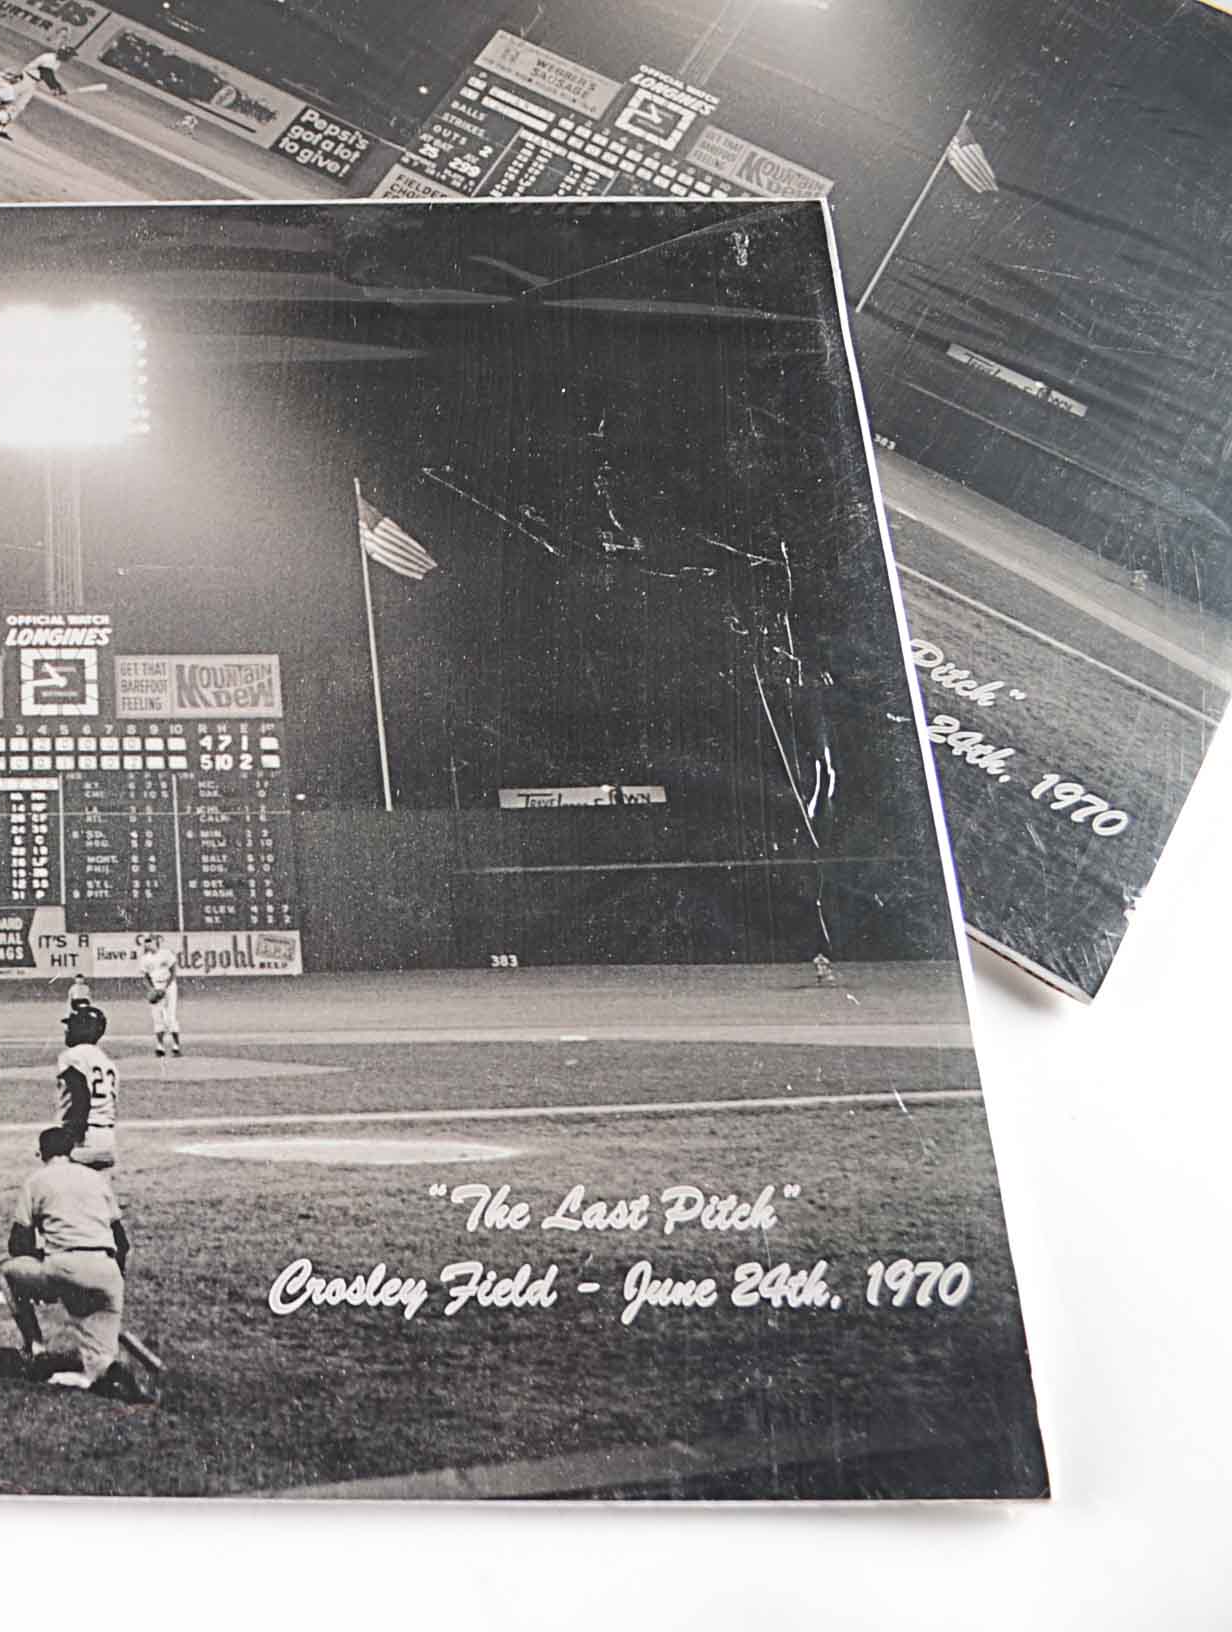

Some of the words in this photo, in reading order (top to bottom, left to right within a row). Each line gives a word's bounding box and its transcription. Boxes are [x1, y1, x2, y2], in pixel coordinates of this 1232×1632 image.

[630, 73, 717, 116] LONGINES
[300, 109, 369, 150] Pepsi's
[279, 137, 300, 154] to
[296, 148, 350, 178] give!
[6, 614, 65, 625] OFFICIAL
[5, 627, 113, 646] LONGINES
[199, 735, 213, 751] 4
[218, 735, 233, 751] 7
[200, 755, 214, 770] 5
[215, 754, 233, 770] 10
[239, 754, 253, 770] 2
[1031, 774, 1129, 836] 1970
[38, 935, 66, 948] IT'S
[78, 934, 90, 948] A
[97, 947, 127, 960] Have
[130, 951, 137, 960] a
[177, 935, 255, 973] depohl
[50, 954, 79, 967] HIT
[429, 1183, 532, 1232] "The
[541, 1183, 651, 1232] Last
[659, 1183, 802, 1234] Pitch"
[268, 1258, 428, 1321] Crosley
[440, 1261, 559, 1316] Field
[577, 1282, 601, 1293] -
[620, 1259, 717, 1325] June
[867, 1258, 971, 1308] 1970
